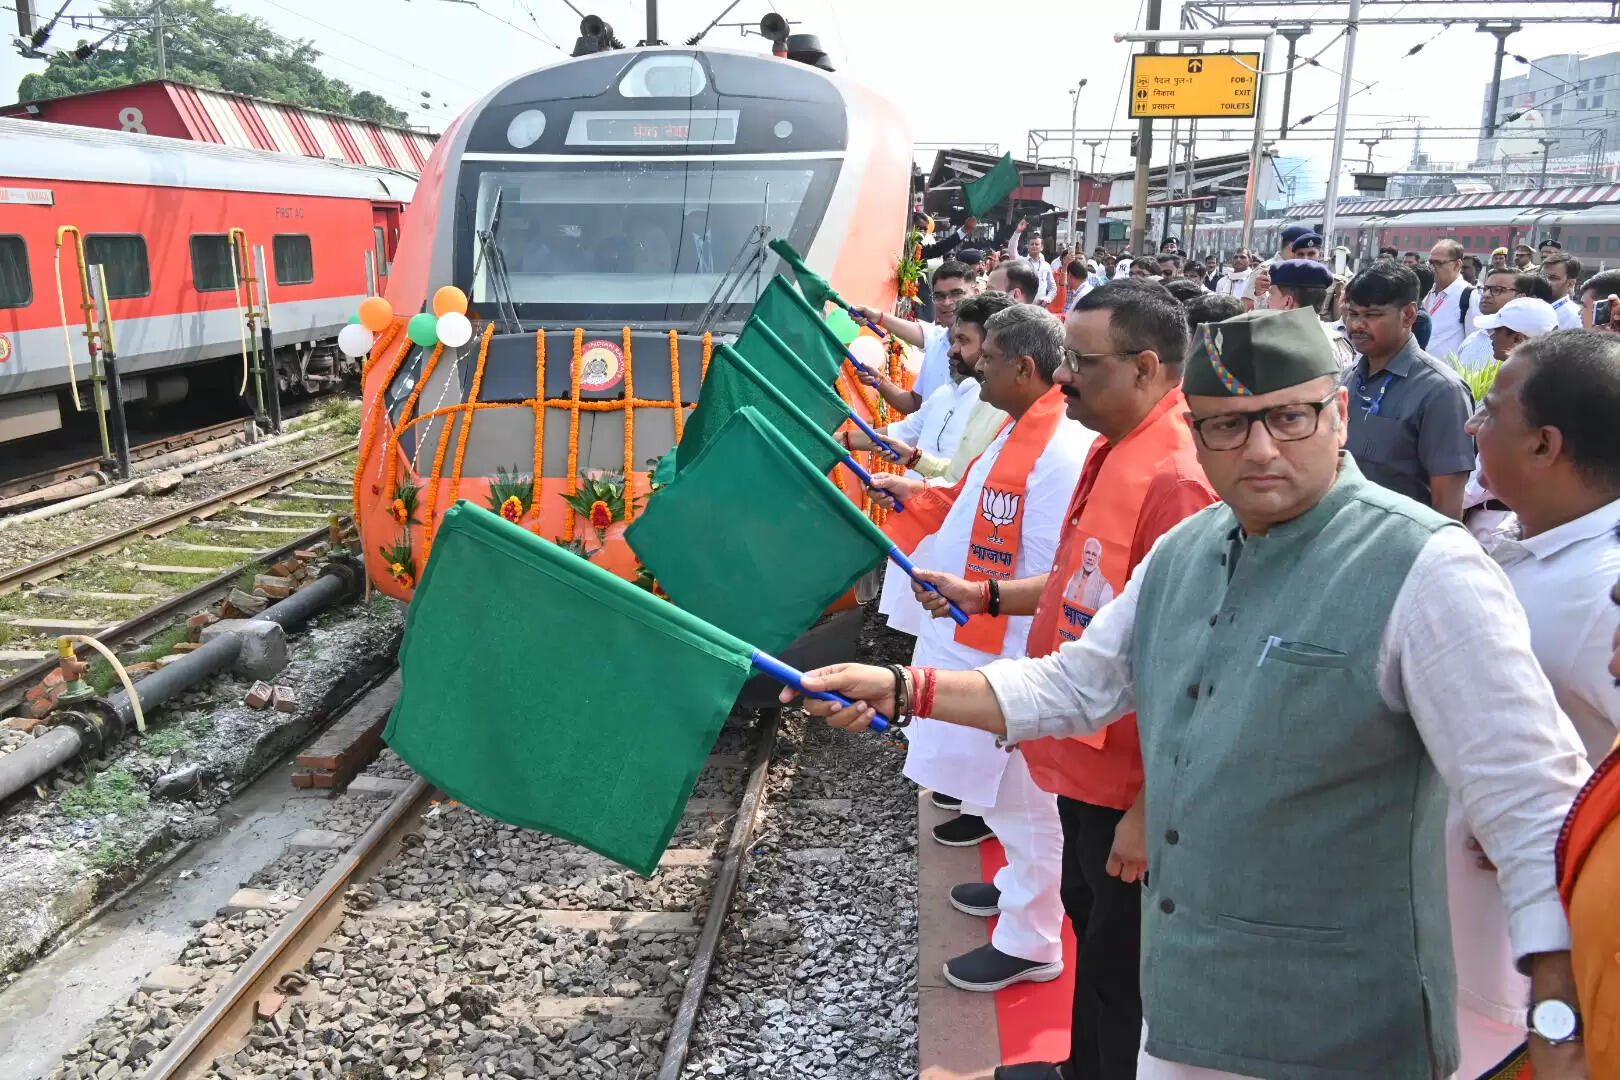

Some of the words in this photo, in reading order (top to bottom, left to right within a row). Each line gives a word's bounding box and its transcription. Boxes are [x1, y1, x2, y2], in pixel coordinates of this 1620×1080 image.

[1230, 76, 1253, 84] FOB-1
[1153, 88, 1175, 97] निकास
[118, 107, 147, 134] 8
[275, 207, 293, 218] FIRST
[970, 543, 1014, 567] भाजपा
[1063, 602, 1094, 629] भाज
